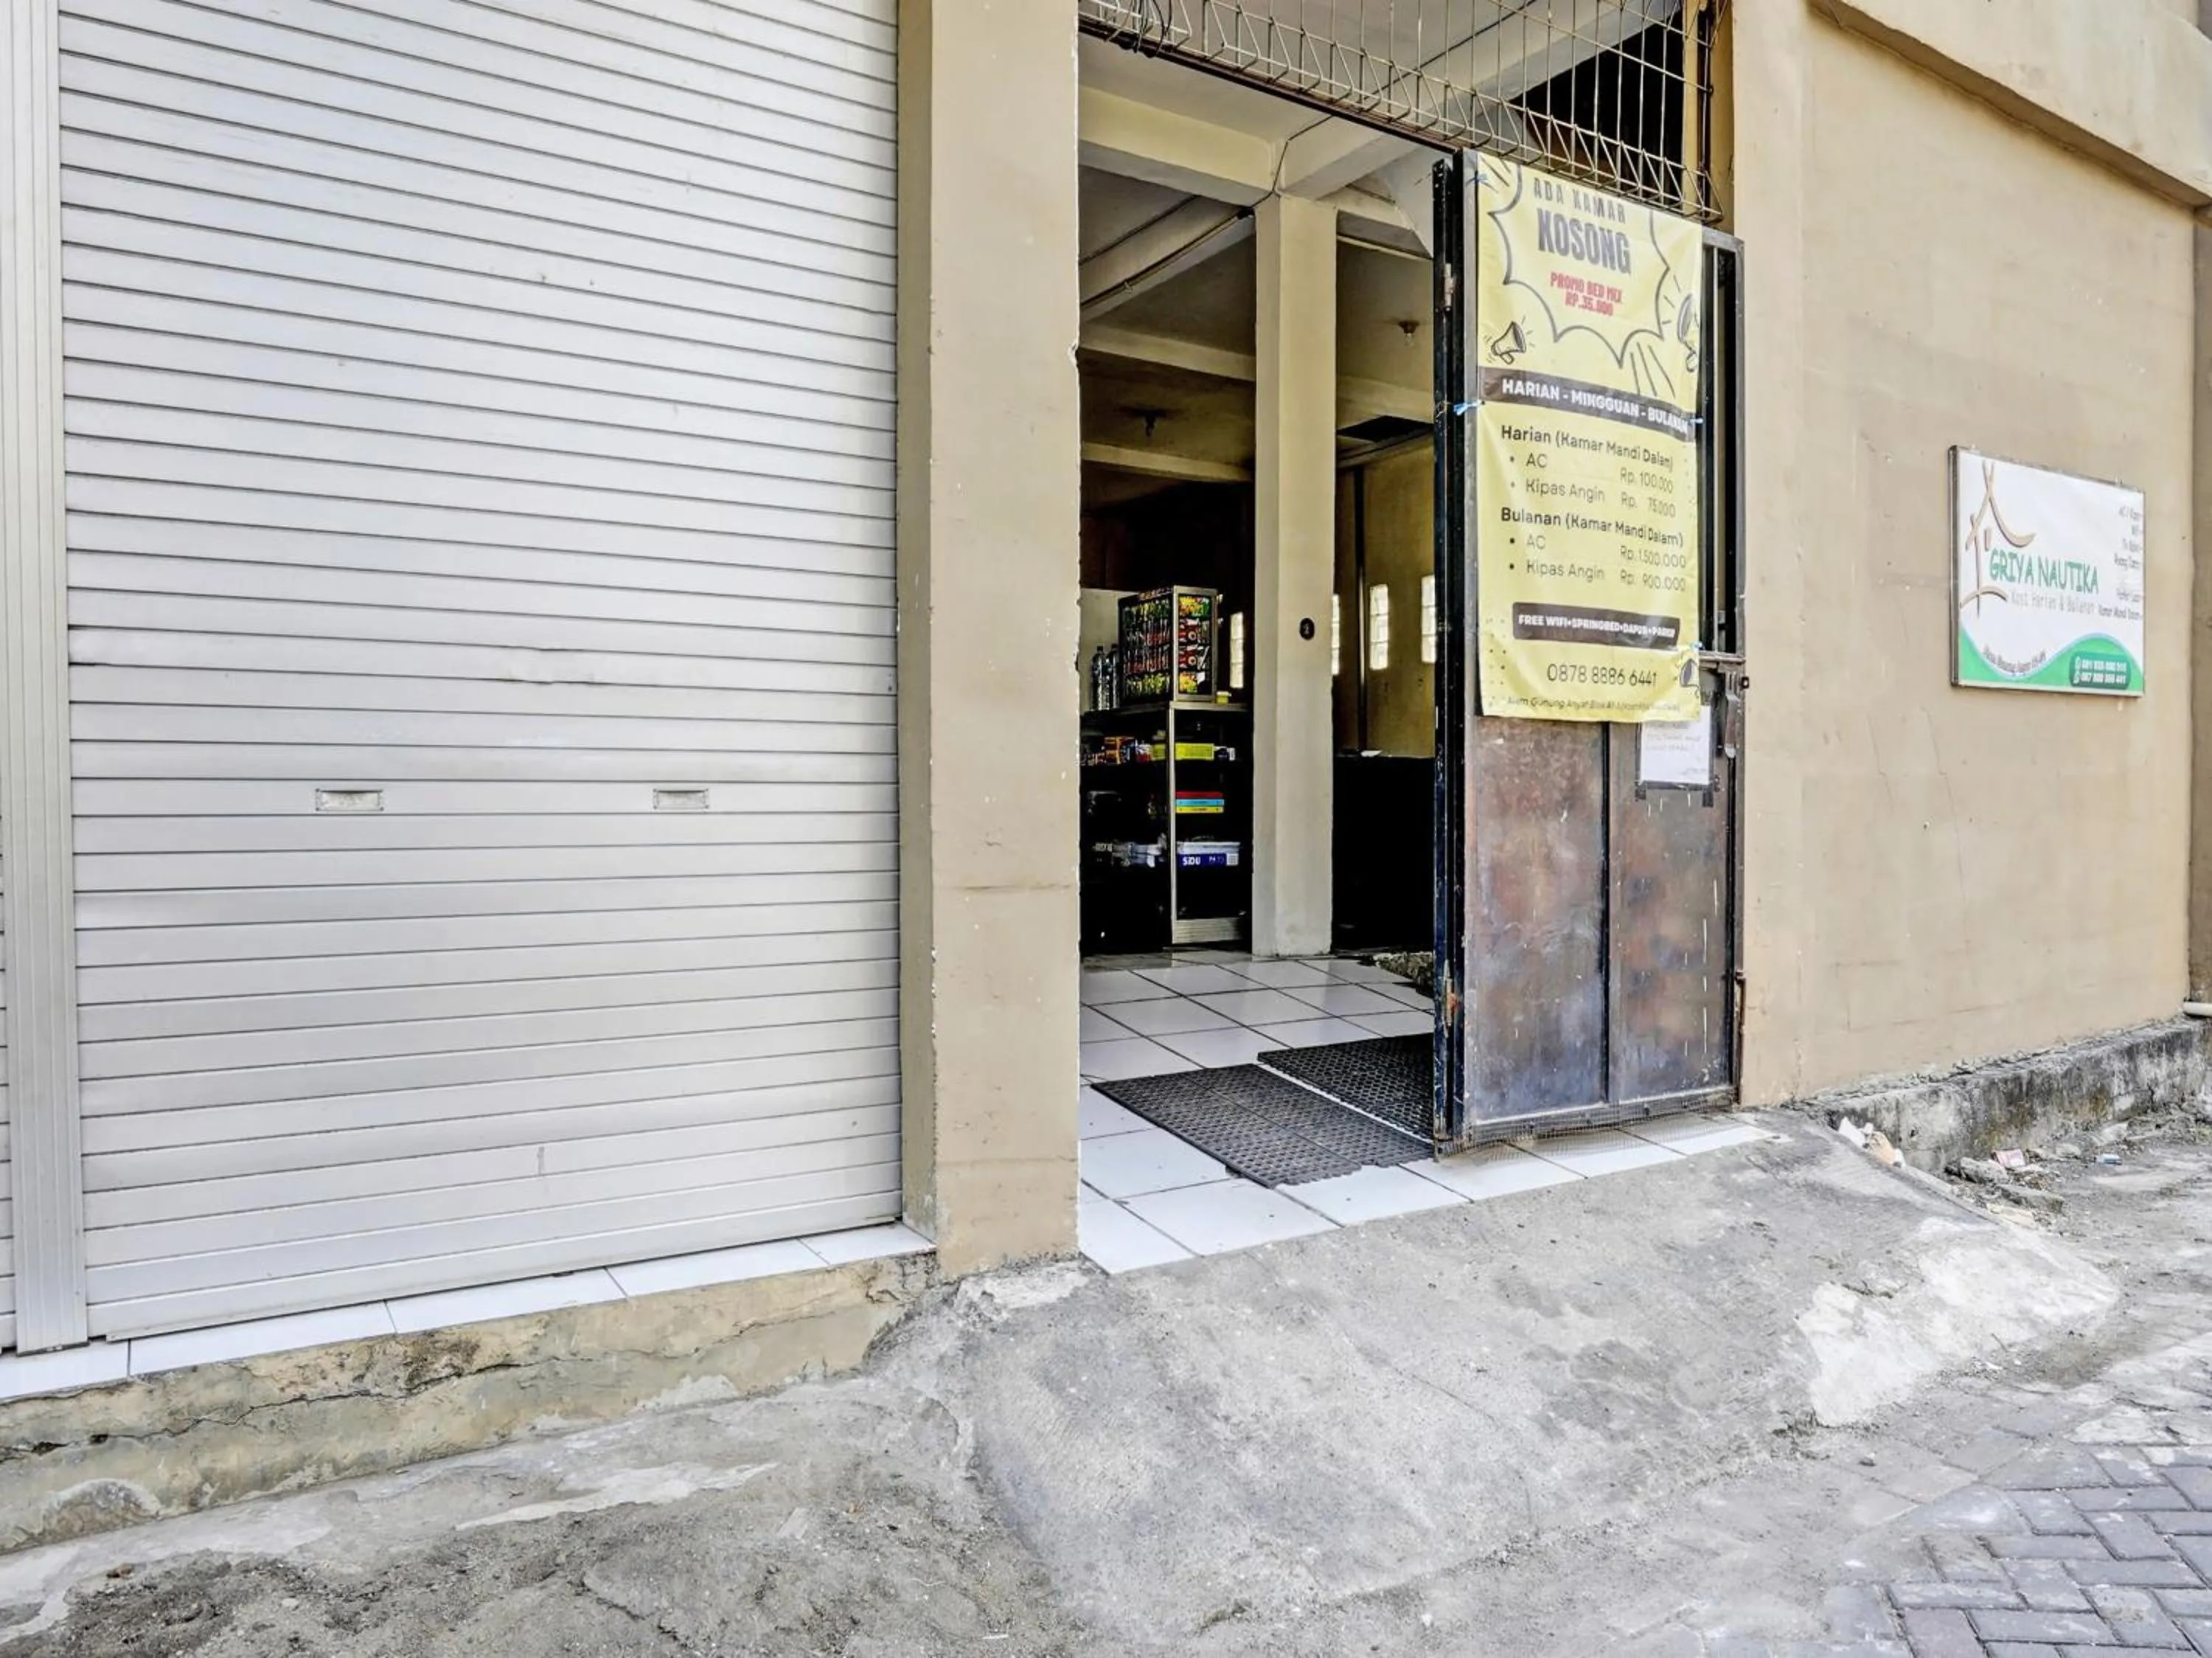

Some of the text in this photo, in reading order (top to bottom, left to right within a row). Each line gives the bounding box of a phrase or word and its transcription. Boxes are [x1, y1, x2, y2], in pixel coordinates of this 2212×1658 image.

[1534, 177, 1625, 223] ADA KAMAR
[1537, 207, 1631, 276] KOSONG
[1550, 271, 1585, 292] PROMO
[1502, 379, 1559, 401] HARIAN
[1571, 389, 1639, 417] MINGGUAN
[1501, 425, 1551, 443] Harian
[1555, 431, 1603, 454] (Kamar
[1606, 441, 1641, 461] Mandi
[1526, 453, 1547, 468] AC
[1526, 479, 1565, 498] Kipas
[1569, 484, 1604, 504] Angin
[1501, 507, 1683, 548] Bulanan (Kamar Mandi Dalam)
[1526, 535, 1546, 549] AC
[1526, 560, 1564, 577] Kipas
[1568, 564, 1604, 583] Angin
[1989, 548, 2034, 585] GRIYA
[2038, 555, 2099, 594] NAUTIKA
[1519, 614, 1545, 626] FREE
[1546, 617, 1568, 628] WIFI
[1547, 663, 1657, 688] 0878 8886 6441
